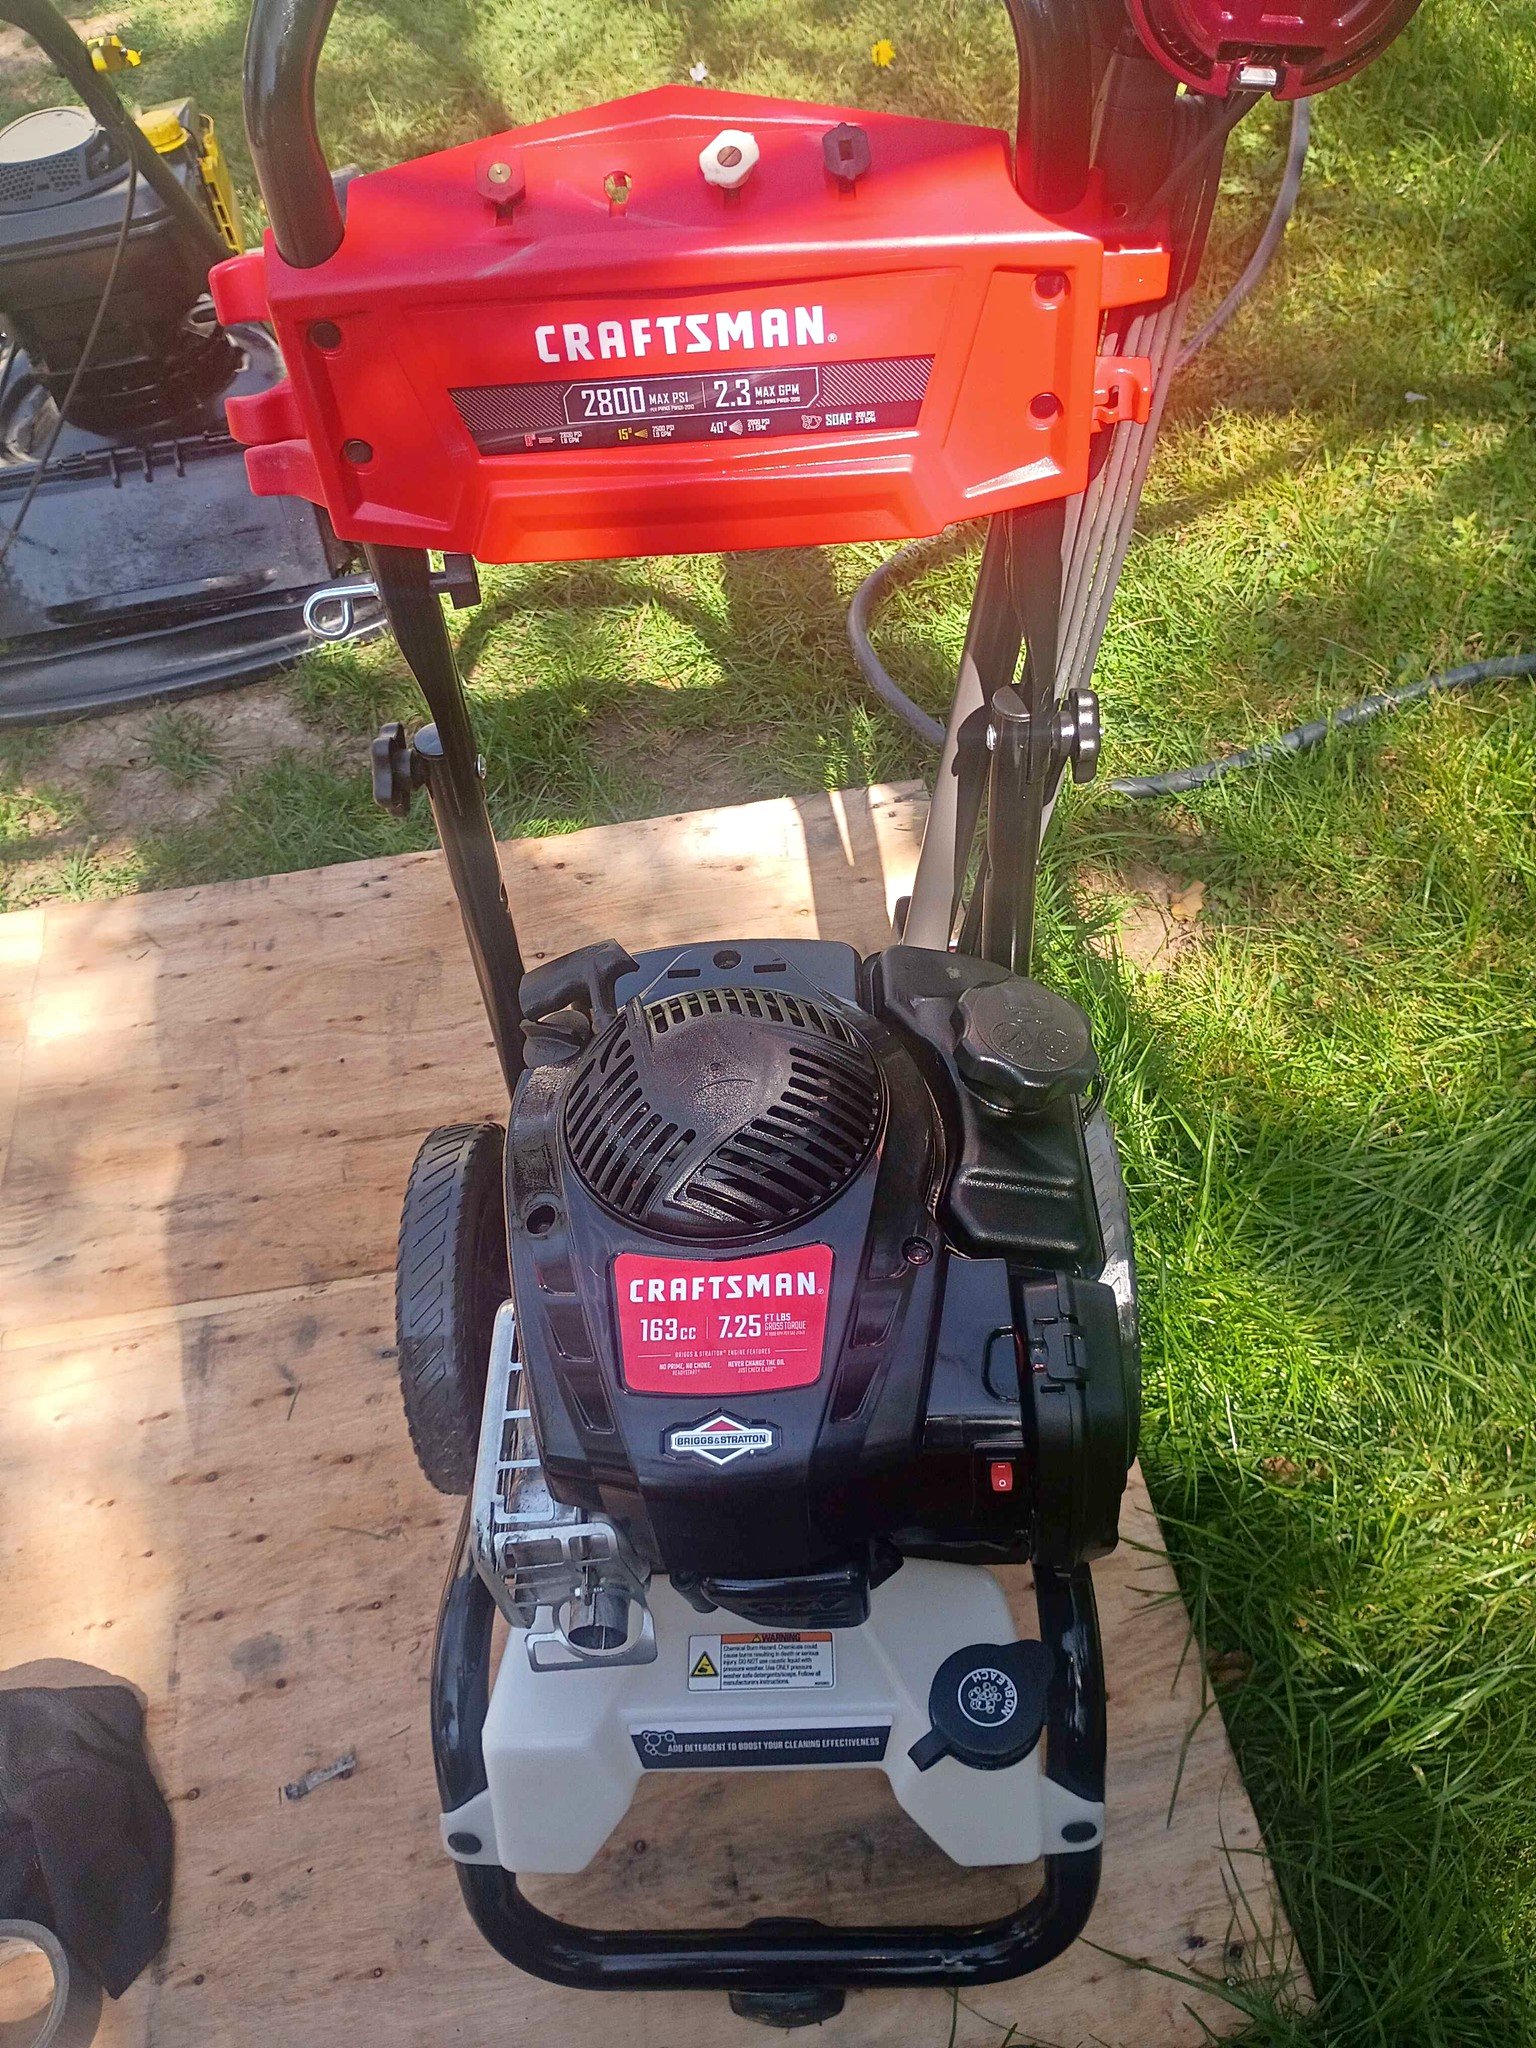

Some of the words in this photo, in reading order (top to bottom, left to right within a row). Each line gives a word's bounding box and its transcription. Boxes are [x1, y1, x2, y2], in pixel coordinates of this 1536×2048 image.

[649, 392, 670, 405] MAX
[672, 391, 689, 404] PSI
[713, 378, 751, 408] 2.3
[754, 386, 776, 398] MAX
[778, 384, 800, 396] GPM
[581, 386, 646, 417] 2800
[825, 412, 852, 426] SOAP
[764, 1313, 774, 1322] FT
[776, 1312, 791, 1322] LBS
[718, 1314, 761, 1339] 7.25
[764, 1321, 784, 1331] GROSS
[784, 1320, 807, 1331] TORQUE
[727, 1360, 744, 1368] NEVER
[762, 1632, 801, 1642] WARNING
[971, 1671, 1014, 1698] BLEACH
[1000, 1699, 1014, 1716] NO
[668, 1744, 683, 1753] ADD
[684, 1742, 725, 1753] DETERGENT
[728, 1742, 736, 1751] TO
[738, 1741, 763, 1750] BOOST
[764, 1741, 782, 1750] YOUR
[784, 1739, 820, 1749] CLEANING
[822, 1737, 879, 1748] EFFECTIVENESS
